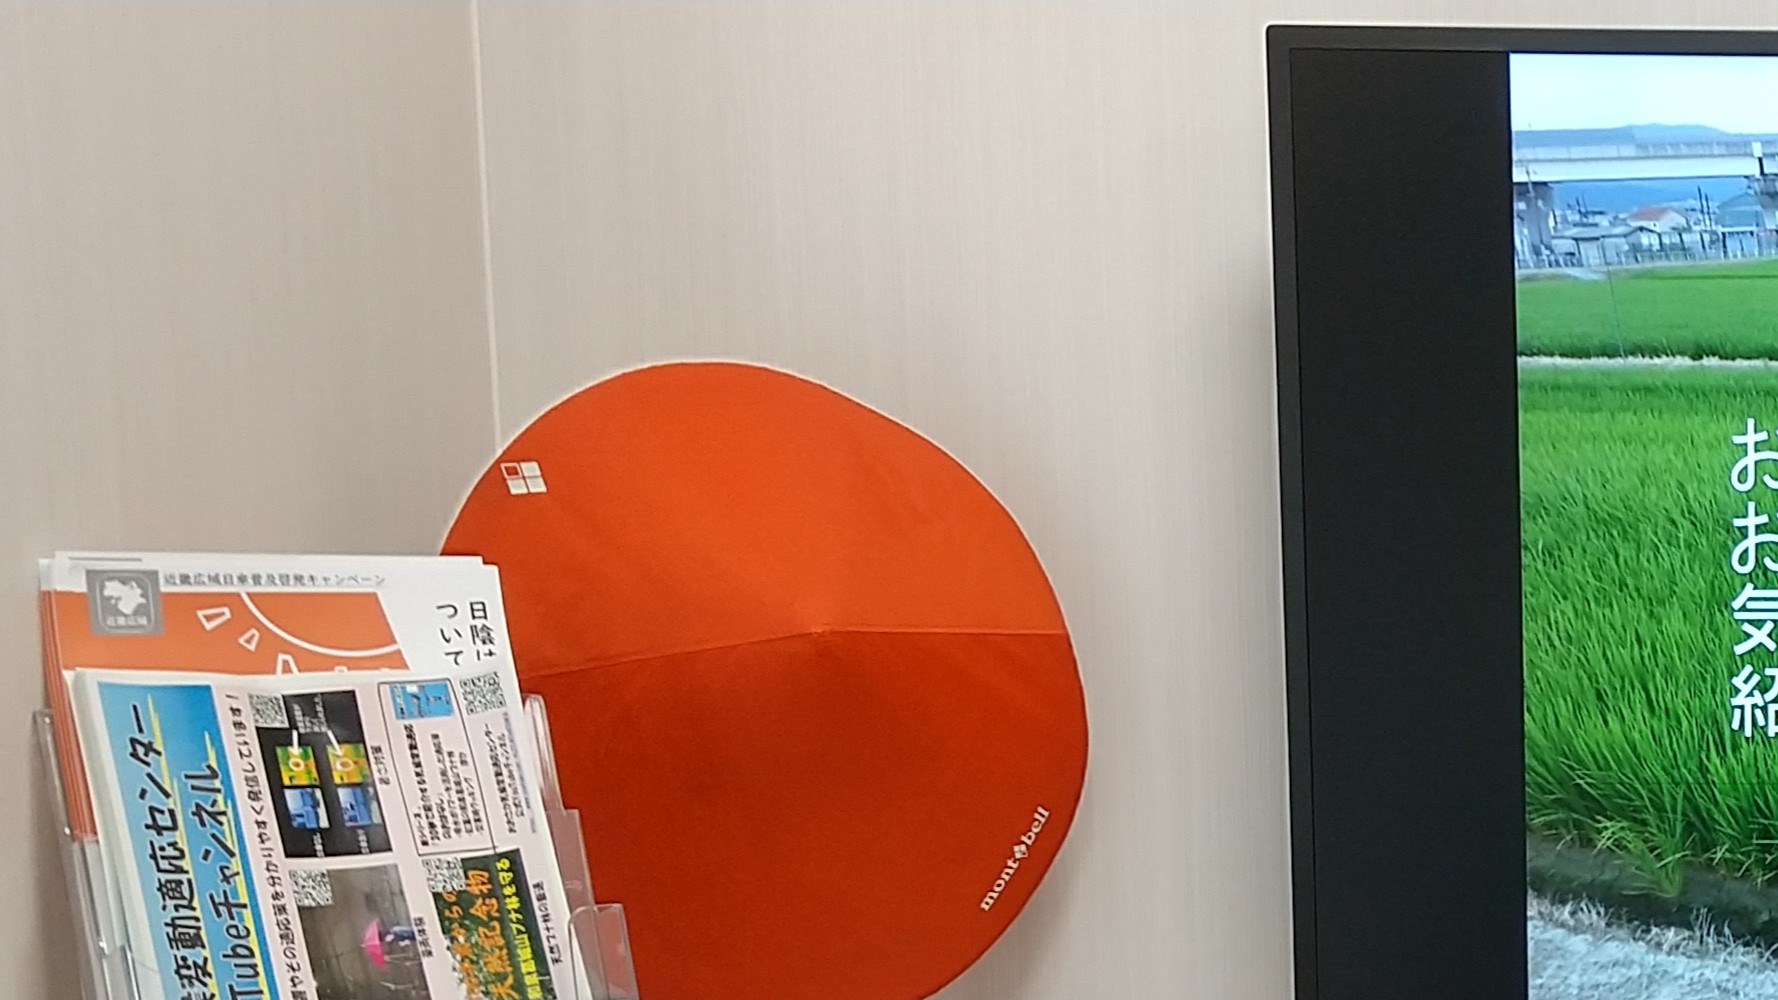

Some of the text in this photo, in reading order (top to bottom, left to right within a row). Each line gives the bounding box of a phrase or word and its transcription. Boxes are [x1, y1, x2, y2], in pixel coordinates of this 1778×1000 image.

[436, 603, 463, 666] ついて
[980, 805, 1050, 912] mont bell
